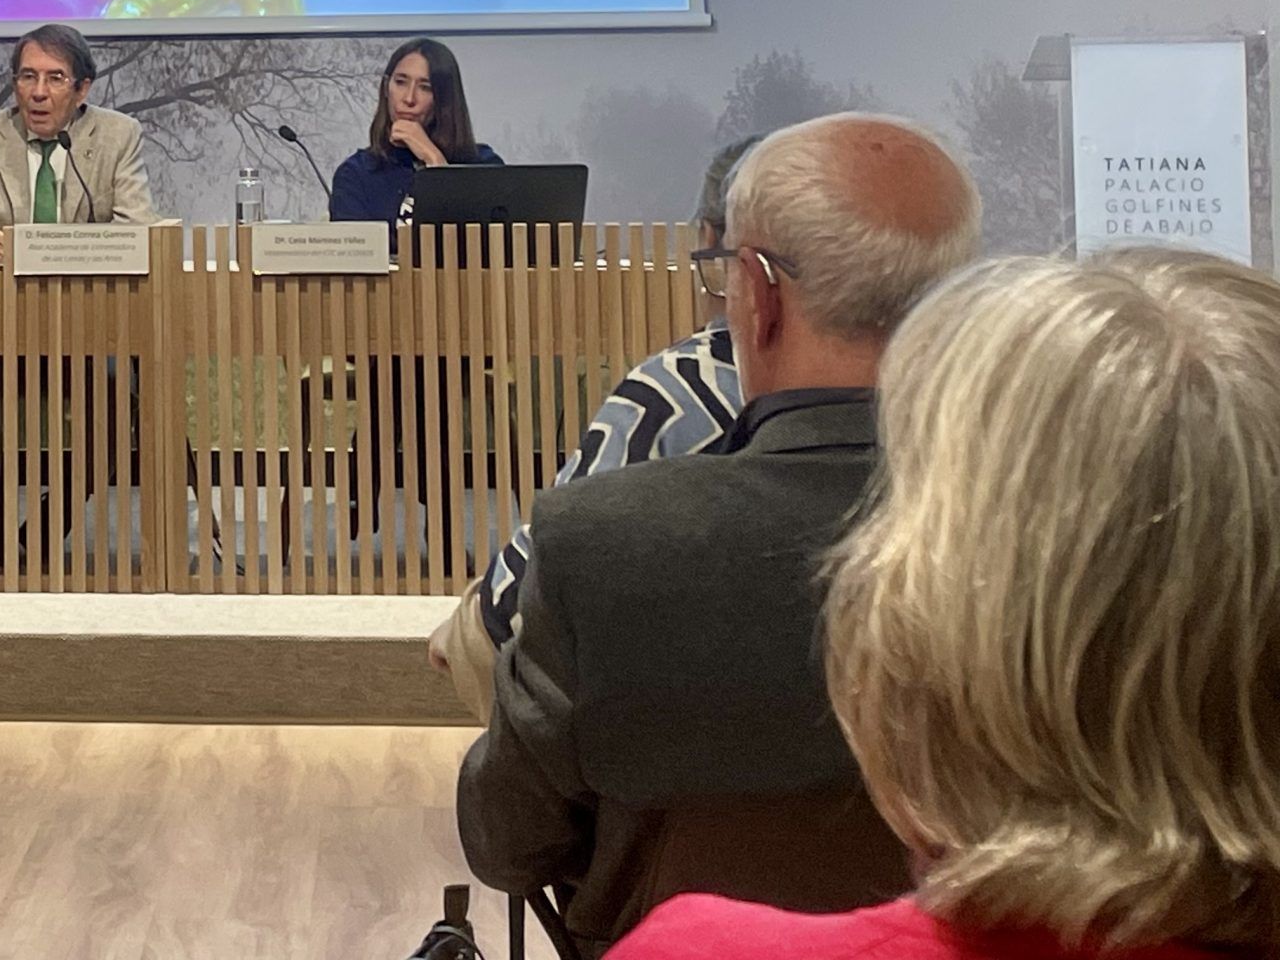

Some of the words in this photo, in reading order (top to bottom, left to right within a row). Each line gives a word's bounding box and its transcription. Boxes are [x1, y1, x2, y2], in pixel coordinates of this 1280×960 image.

[1104, 156, 1207, 172] TATIANA
[1105, 177, 1205, 192] PALACIO
[1105, 197, 1223, 214] GOLFINES
[1106, 219, 1133, 235] DE
[1141, 219, 1214, 237] ABAJO
